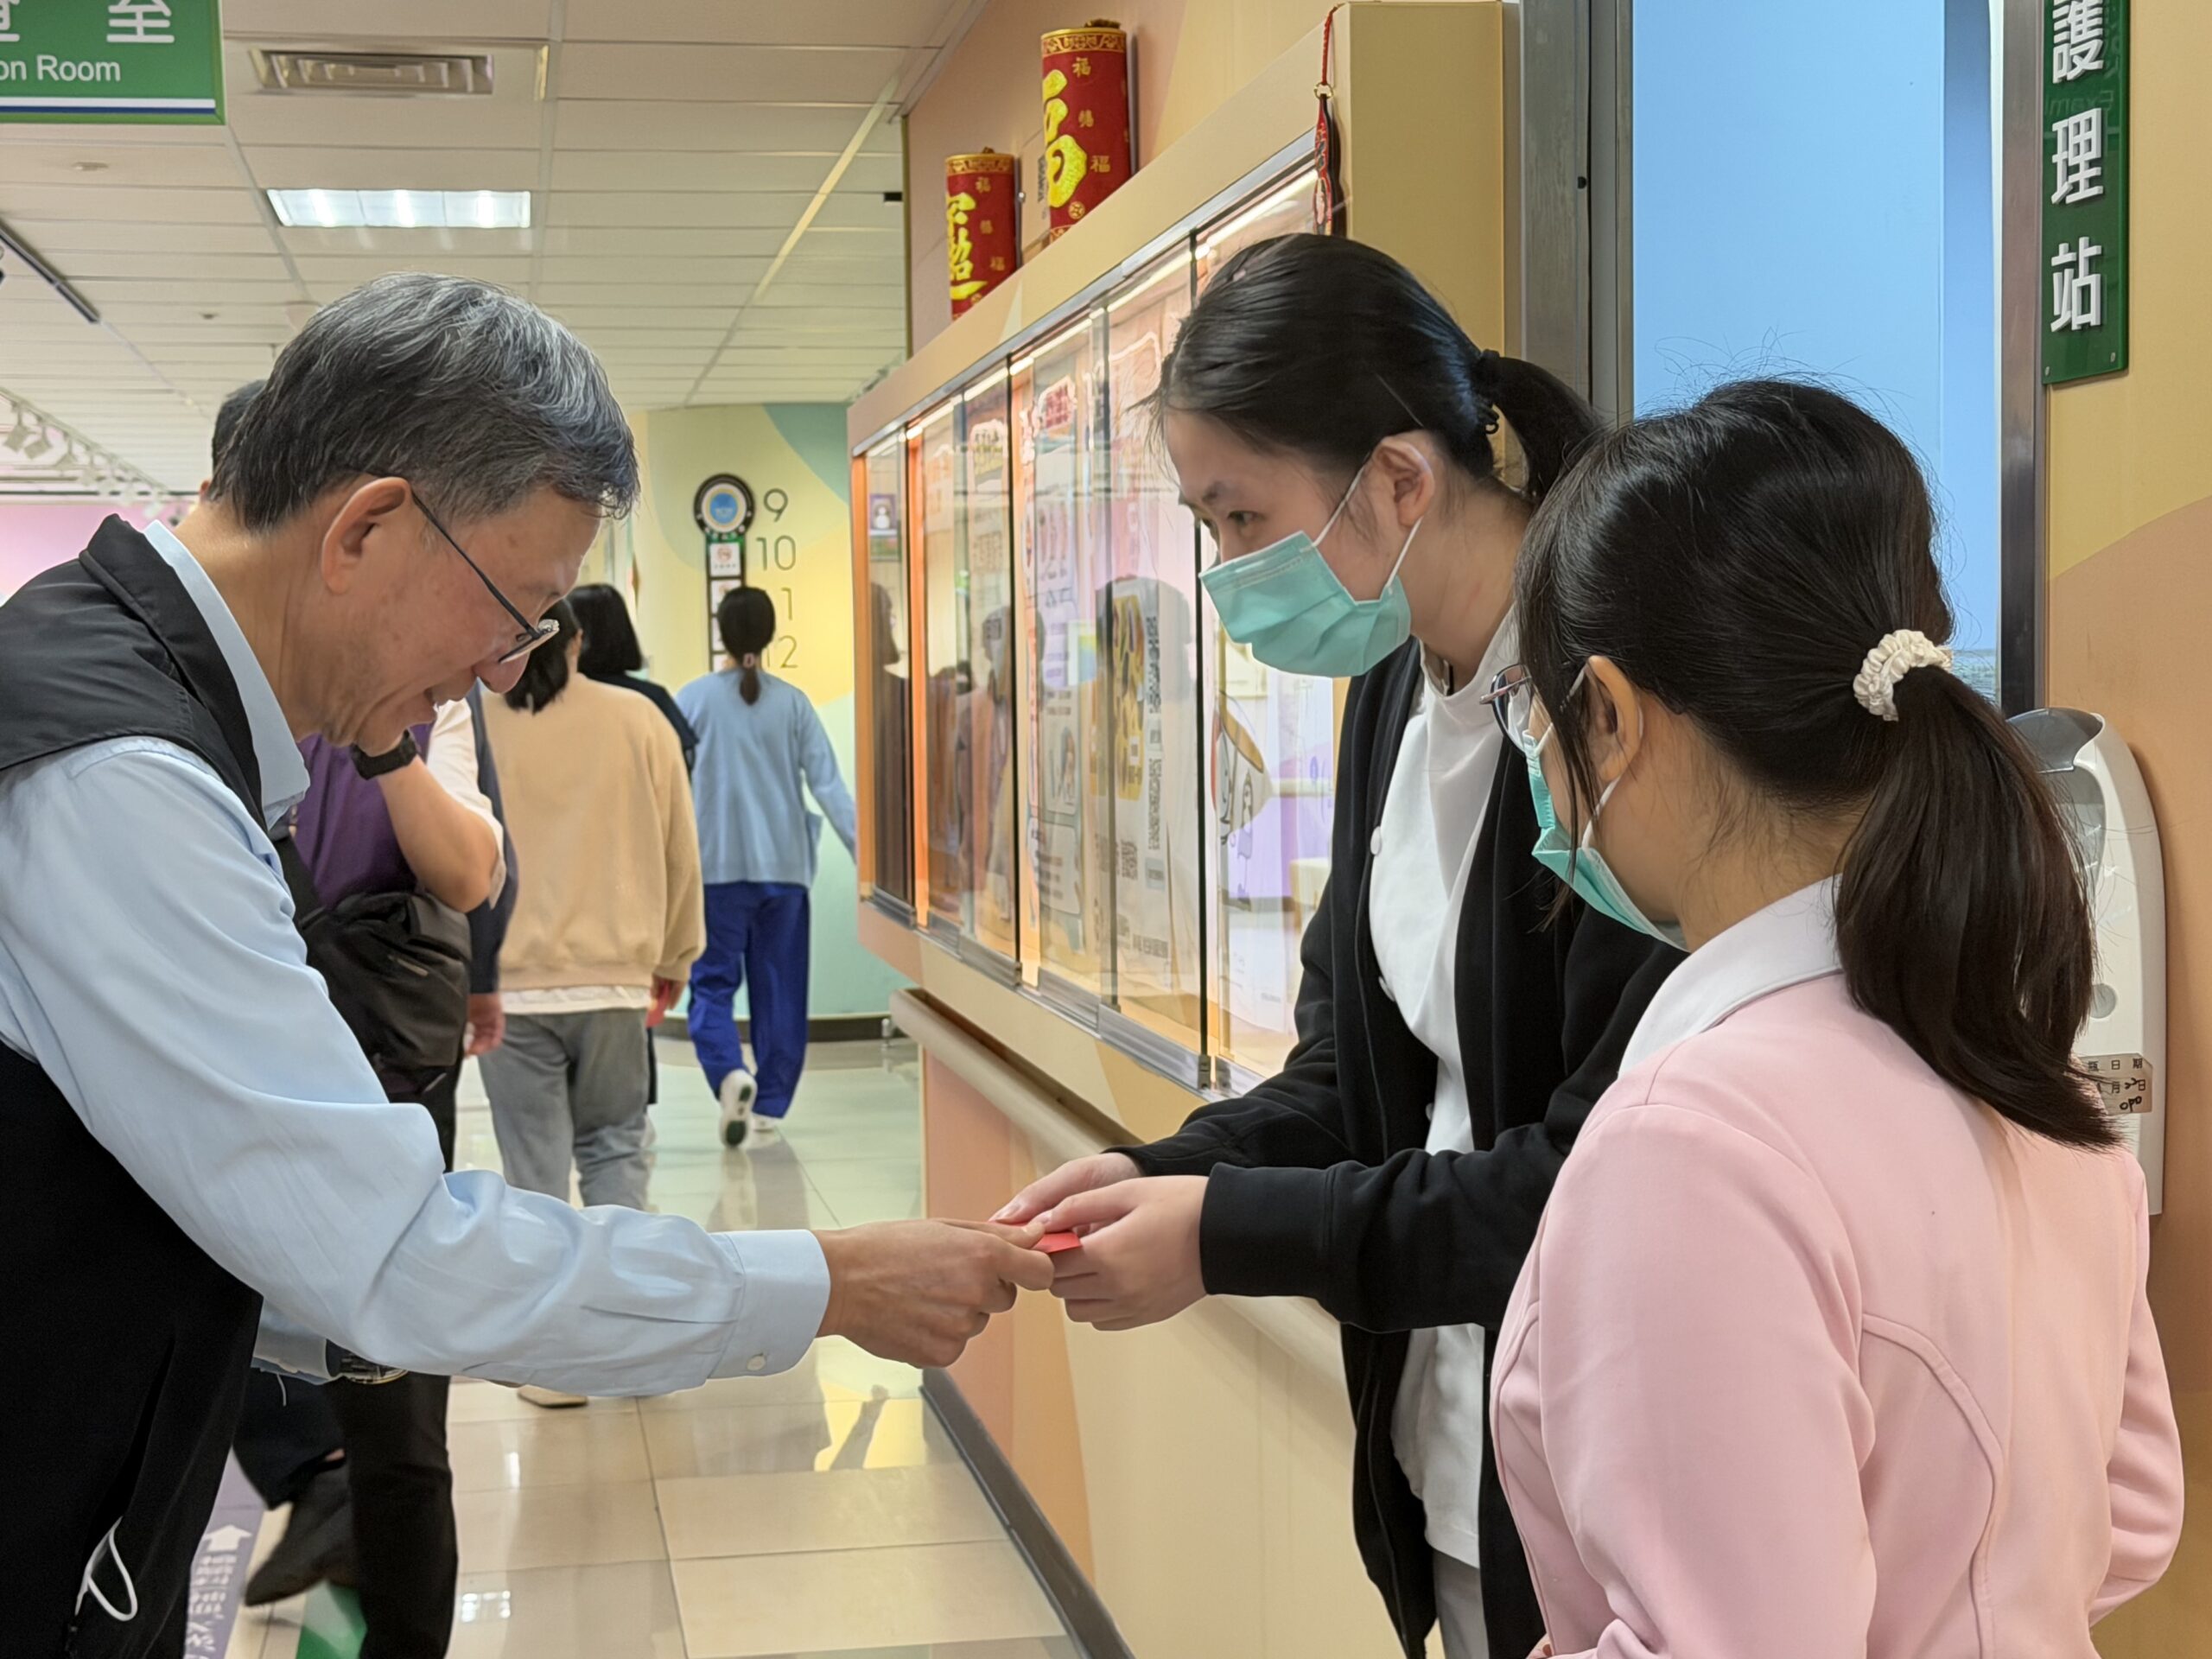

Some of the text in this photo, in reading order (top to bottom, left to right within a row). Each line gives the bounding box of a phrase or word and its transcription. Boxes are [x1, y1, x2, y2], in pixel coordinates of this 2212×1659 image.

[36, 54, 121, 81] Room
[1071, 56, 1091, 78] 福
[2050, 0, 2105, 333] 護理站
[763, 488, 788, 523] 9
[755, 535, 797, 571] 10
[781, 587, 793, 620] 1
